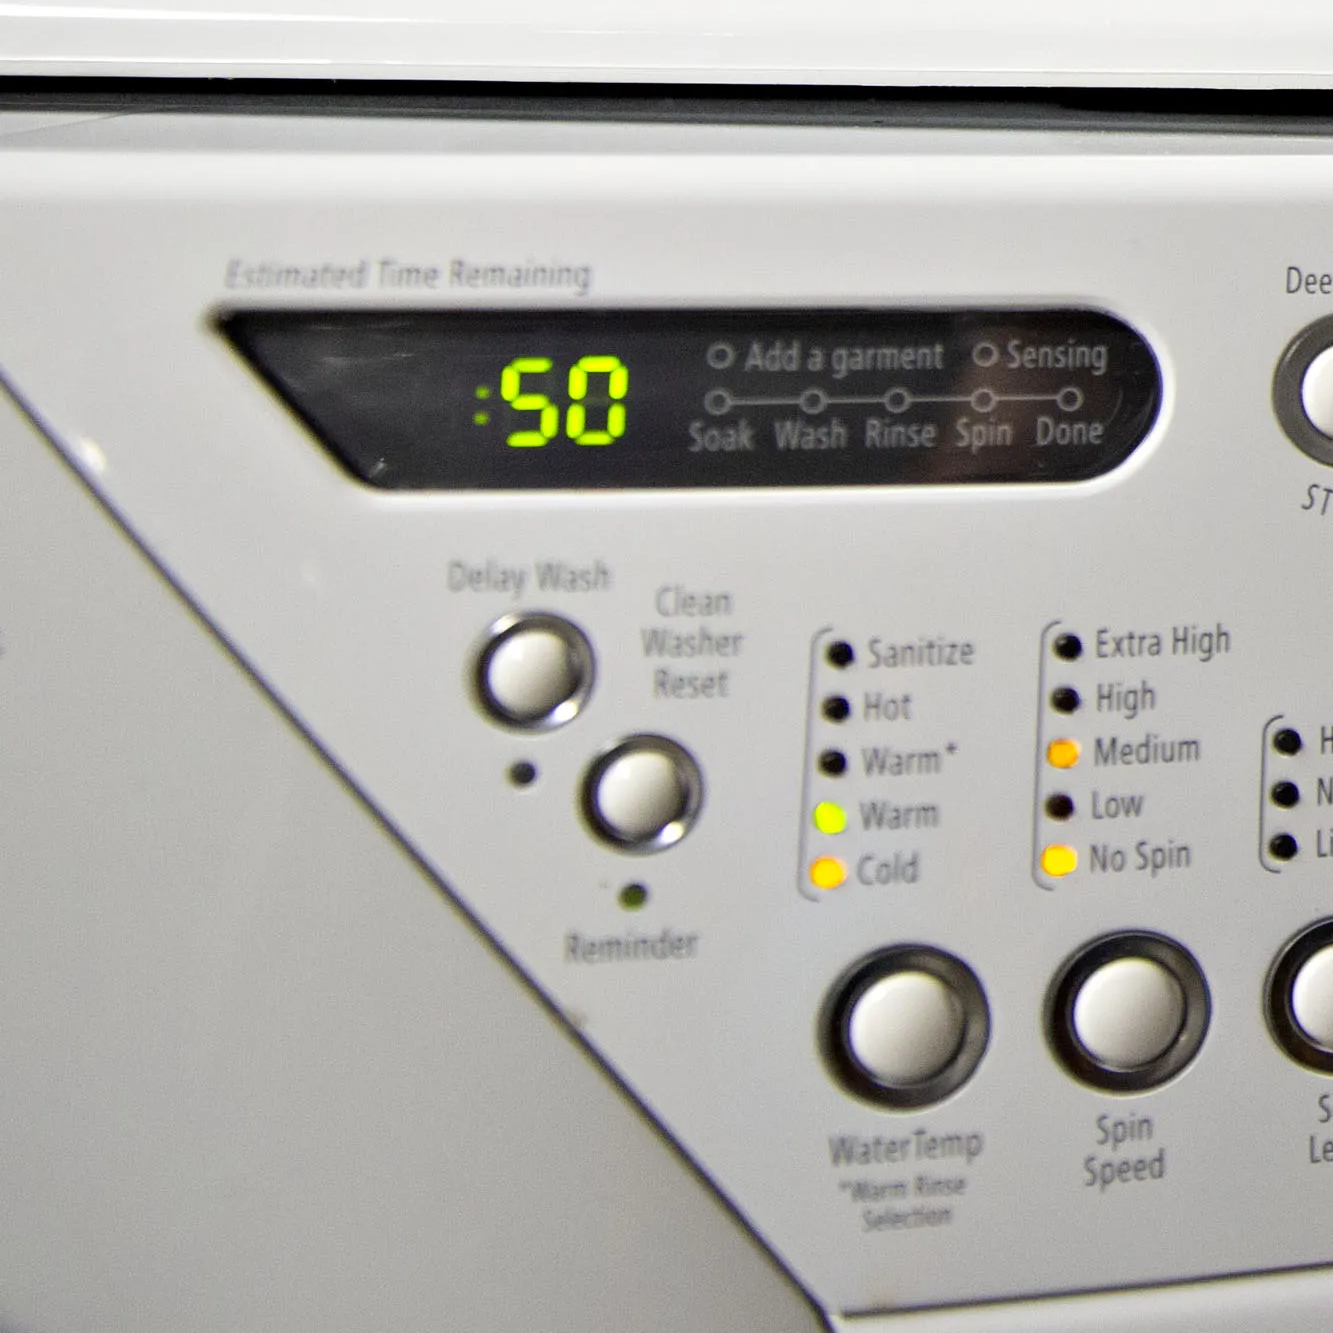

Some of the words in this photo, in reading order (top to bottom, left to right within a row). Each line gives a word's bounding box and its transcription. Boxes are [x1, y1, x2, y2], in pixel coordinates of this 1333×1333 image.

[224, 259, 368, 289] Estimated
[378, 261, 438, 289] Time
[449, 260, 591, 295] Remaining
[745, 342, 798, 370] Add
[808, 349, 827, 370] a
[831, 343, 944, 378] garment
[1007, 340, 1108, 375] Sensing
[688, 421, 754, 452] Soak
[775, 421, 848, 449] Wash
[865, 420, 936, 448] Rinse
[957, 420, 1013, 453] Spin
[1037, 418, 1103, 445] Done
[447, 561, 526, 598] Delay
[536, 561, 613, 591] Wash
[656, 585, 732, 616] Clean
[641, 627, 743, 658] Washer
[867, 638, 976, 667] Sanitize
[1096, 628, 1162, 659] Extra
[1172, 625, 1230, 662] High
[653, 670, 729, 698] Reset
[1096, 681, 1156, 719] High
[863, 693, 912, 720] Hot
[1093, 734, 1199, 767] Medium
[859, 802, 939, 830] Warm
[1091, 792, 1143, 820] Low
[856, 852, 919, 885] Cold
[1090, 844, 1125, 873] No
[1135, 840, 1191, 876] Spin
[565, 930, 699, 963] Reminder
[1096, 1113, 1153, 1152] Spin
[915, 1174, 966, 1198] Rinse
[1084, 1149, 1166, 1193] Speed
[862, 1205, 953, 1233] Selection
